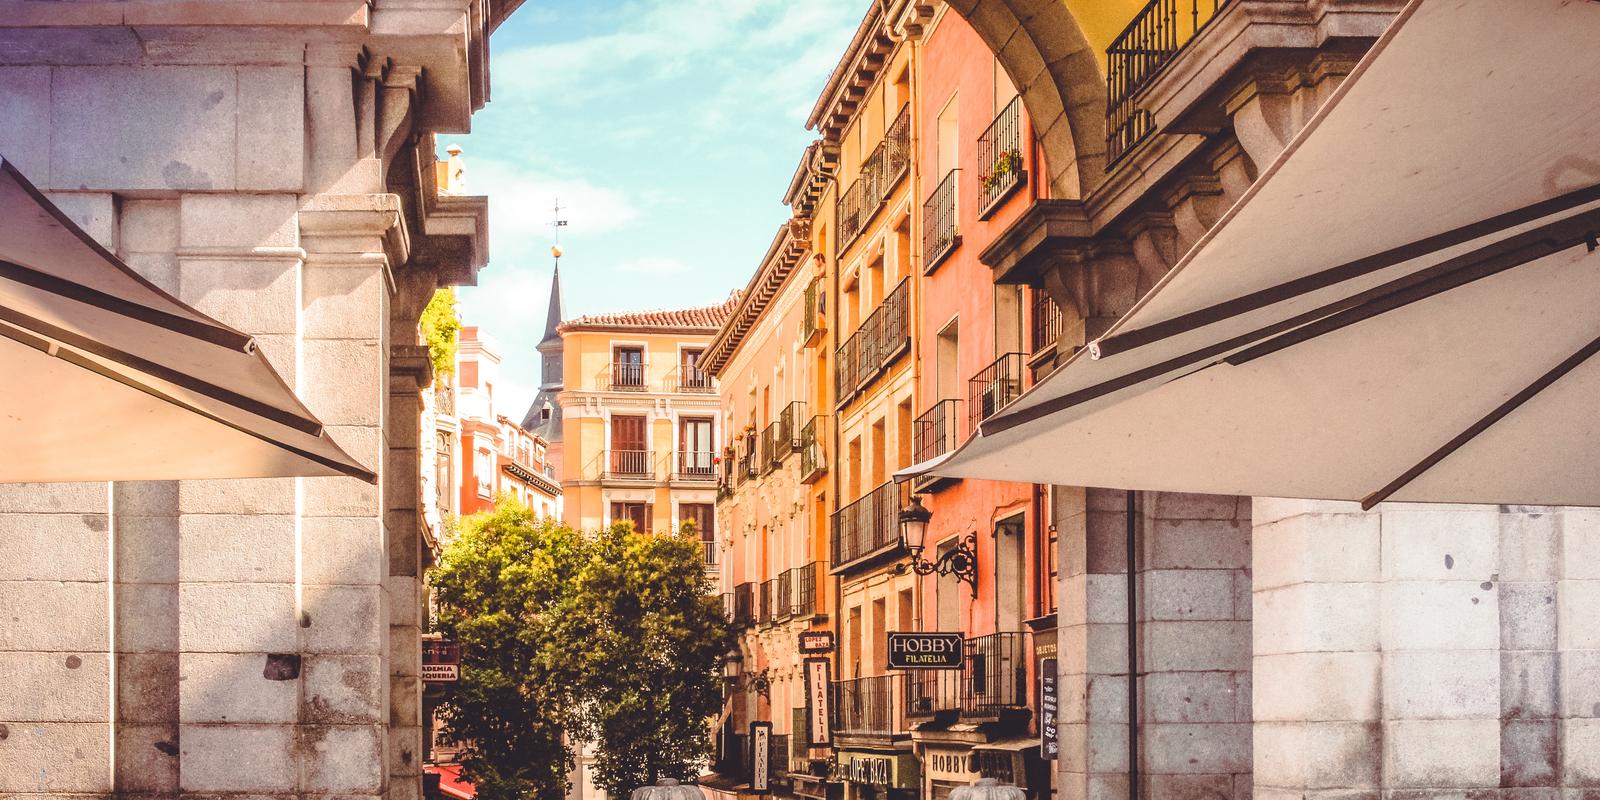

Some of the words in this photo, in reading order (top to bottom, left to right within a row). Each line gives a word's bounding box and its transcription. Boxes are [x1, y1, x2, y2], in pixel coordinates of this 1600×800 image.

[893, 638, 959, 652] HOBBY
[905, 654, 947, 663] FILATELIA
[816, 664, 826, 743] FILATELIA
[870, 757, 888, 785] BAZA
[932, 754, 967, 774] HOBBY
